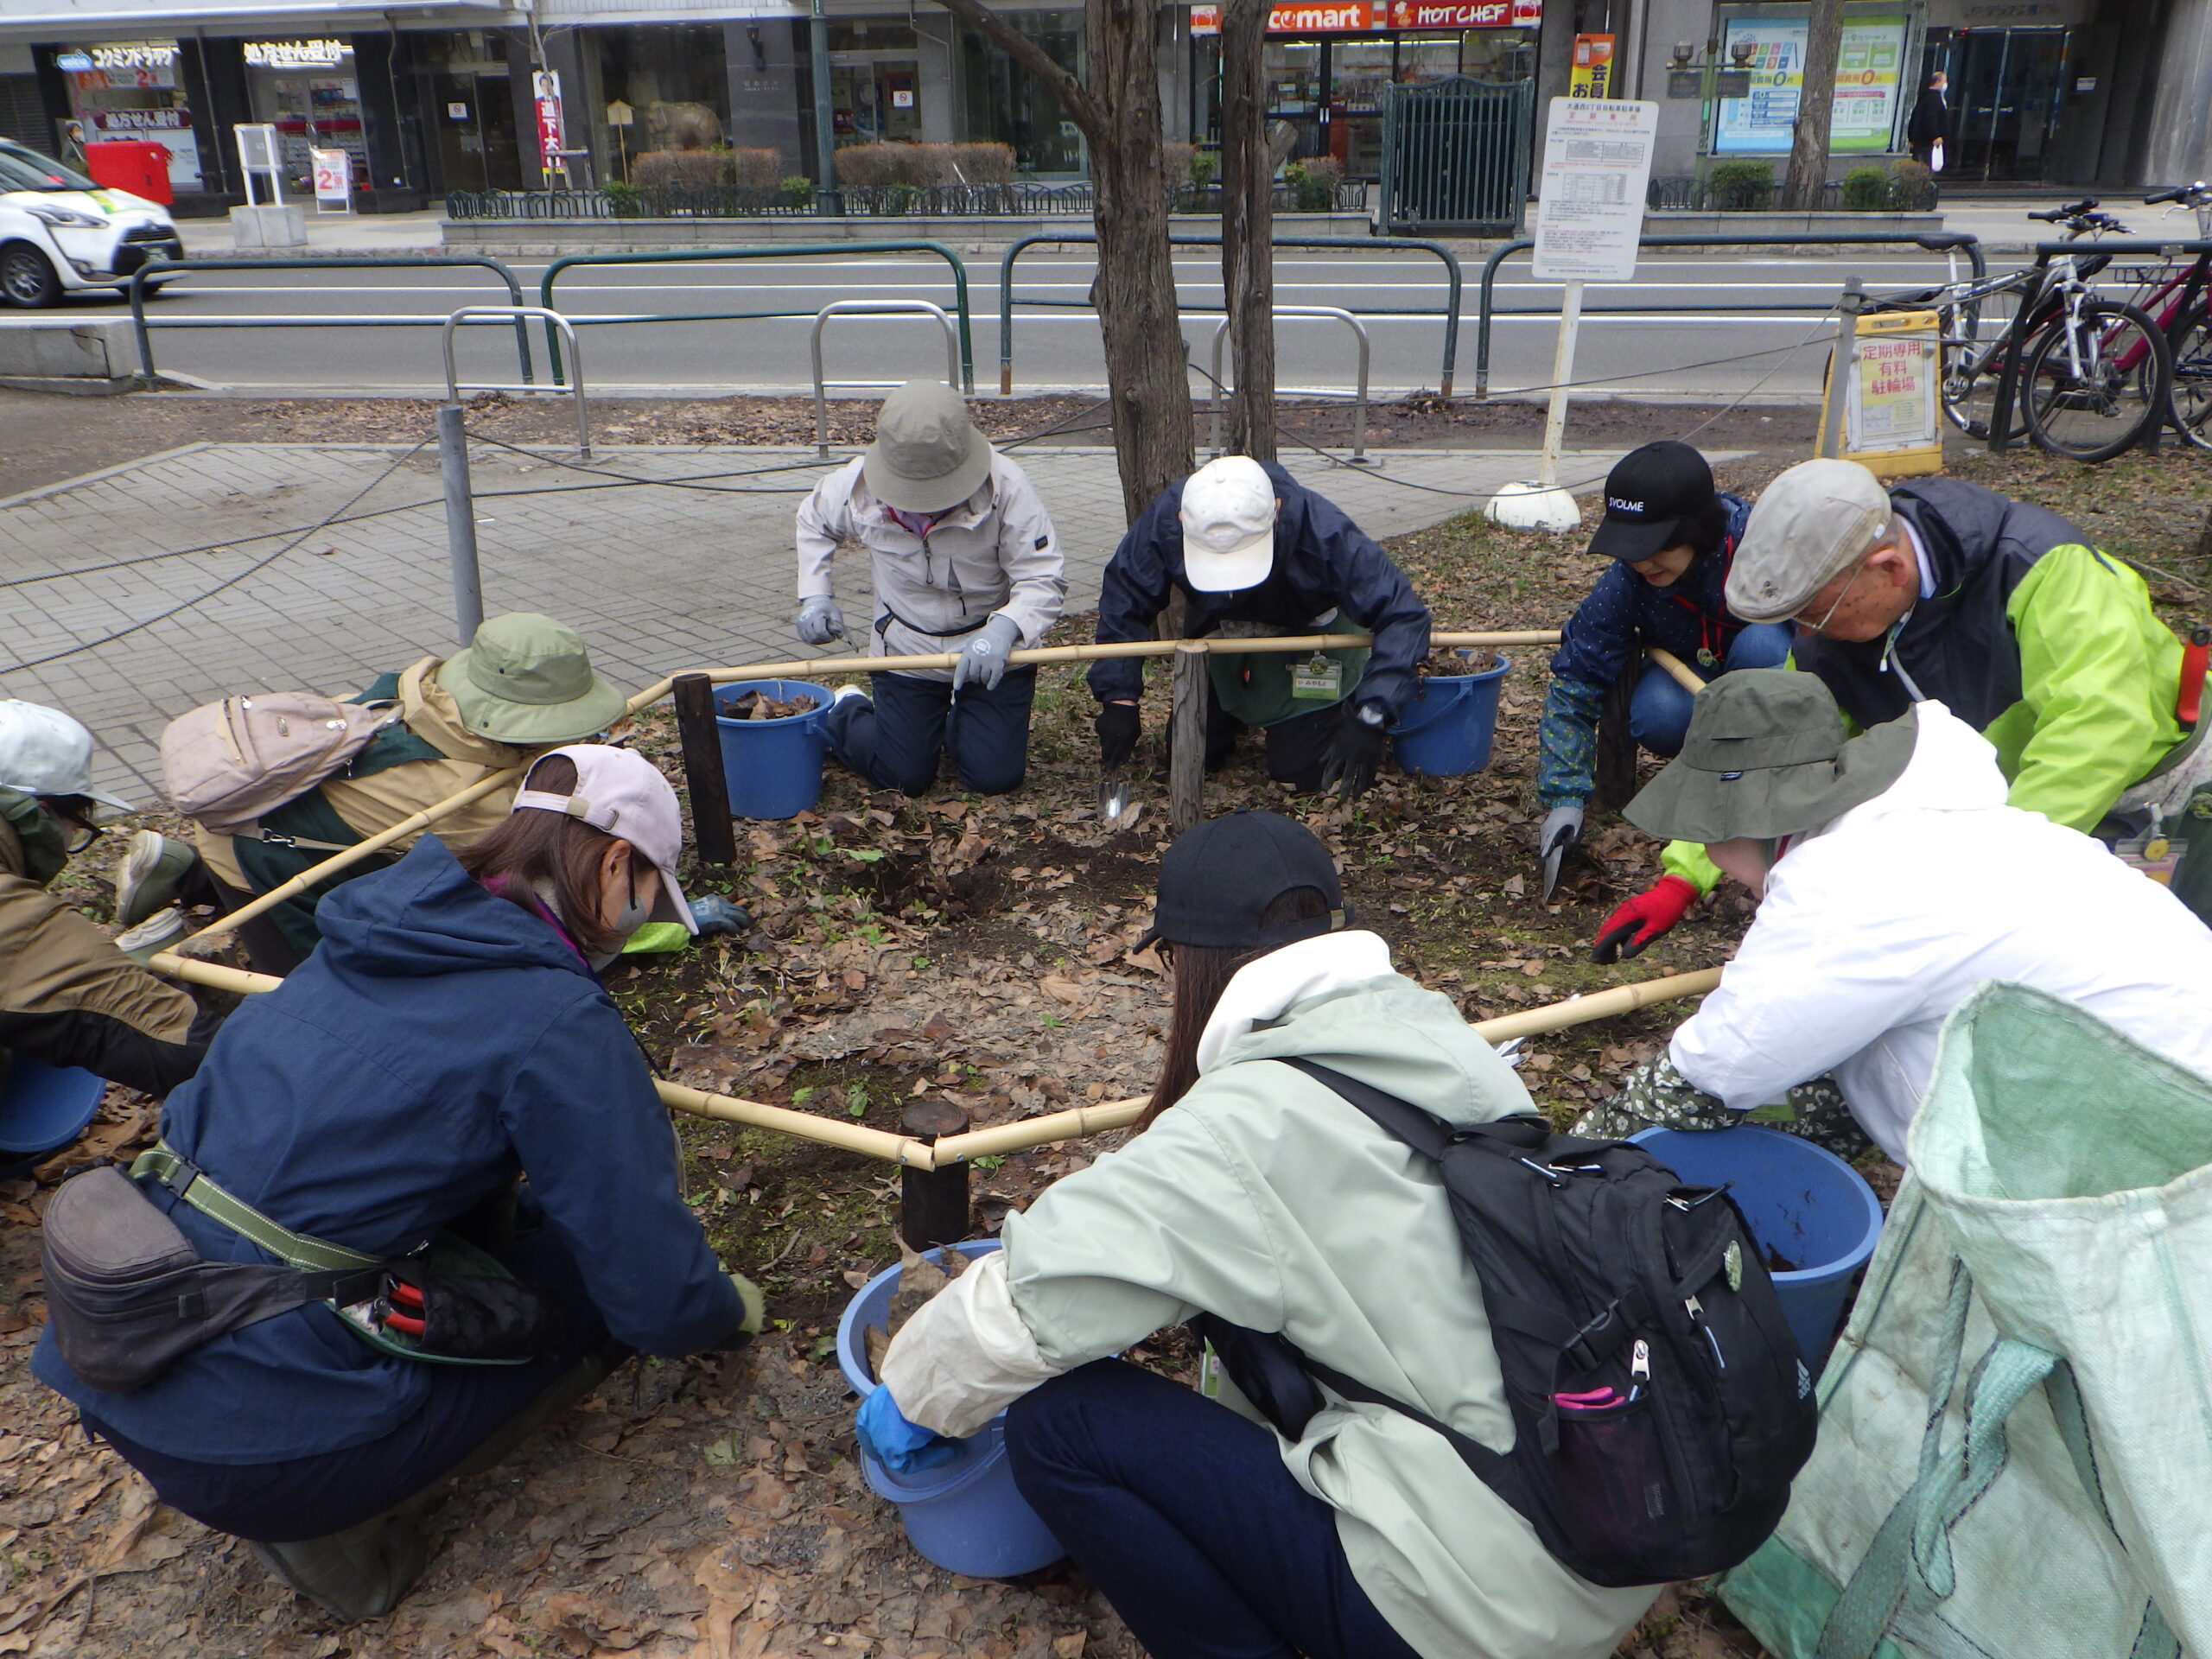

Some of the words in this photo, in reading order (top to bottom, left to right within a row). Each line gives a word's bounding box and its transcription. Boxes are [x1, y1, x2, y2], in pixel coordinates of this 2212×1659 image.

[1268, 4, 1360, 28] comart
[1417, 5, 1456, 25] HOT
[1457, 3, 1509, 23] CHEF
[92, 47, 176, 69] コクミンドラッグ
[244, 40, 342, 65] 処方せん受付
[1573, 83, 1588, 98] お
[1591, 64, 1607, 99] 会員
[105, 111, 181, 128] 処方せん受付
[1863, 340, 1921, 360] 定期専用
[1878, 359, 1907, 377] 有料
[1872, 375, 1916, 396] 駐輪場
[1609, 496, 1645, 512] SVOLME
